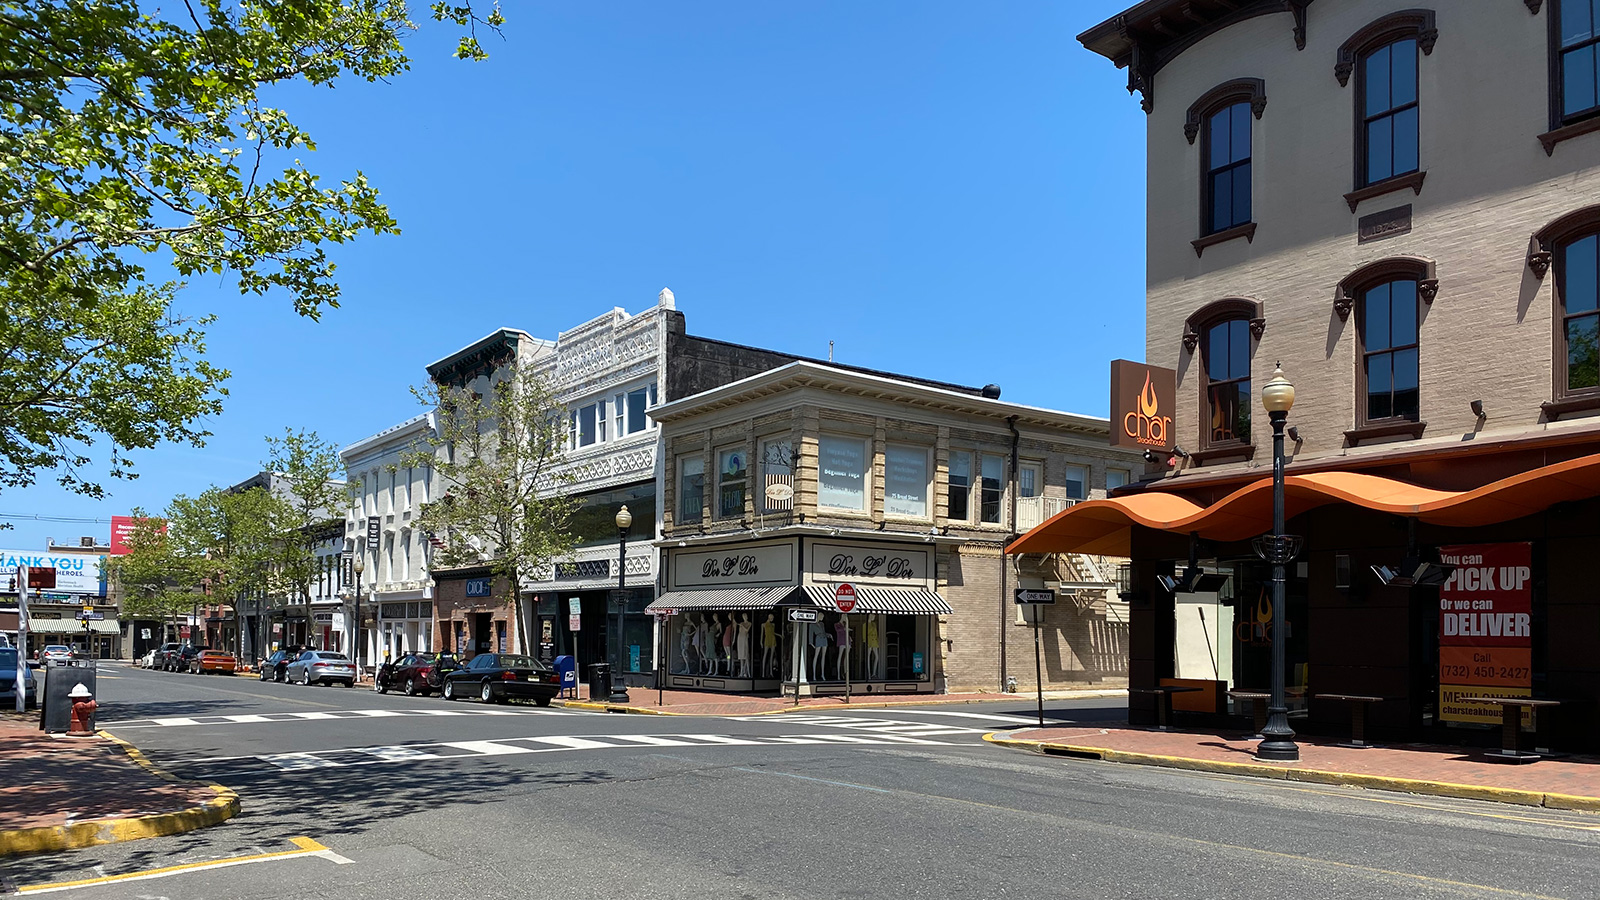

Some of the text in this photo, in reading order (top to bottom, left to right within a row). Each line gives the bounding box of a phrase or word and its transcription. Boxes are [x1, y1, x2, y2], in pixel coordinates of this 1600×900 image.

[1124, 395, 1172, 441] char
[1137, 437, 1166, 447] steakhouse
[48, 557, 84, 571] YOU
[702, 558, 720, 578] Dor
[738, 555, 758, 576] Dor
[828, 554, 859, 576] Dor
[886, 557, 914, 579] Dor
[1441, 554, 1482, 565] You can
[1444, 566, 1530, 591] PICK UP
[1440, 599, 1493, 610] Or we can
[1444, 613, 1530, 637] DELIVER
[1473, 653, 1491, 663] Call
[1441, 665, 1529, 679] (732) 450-2427
